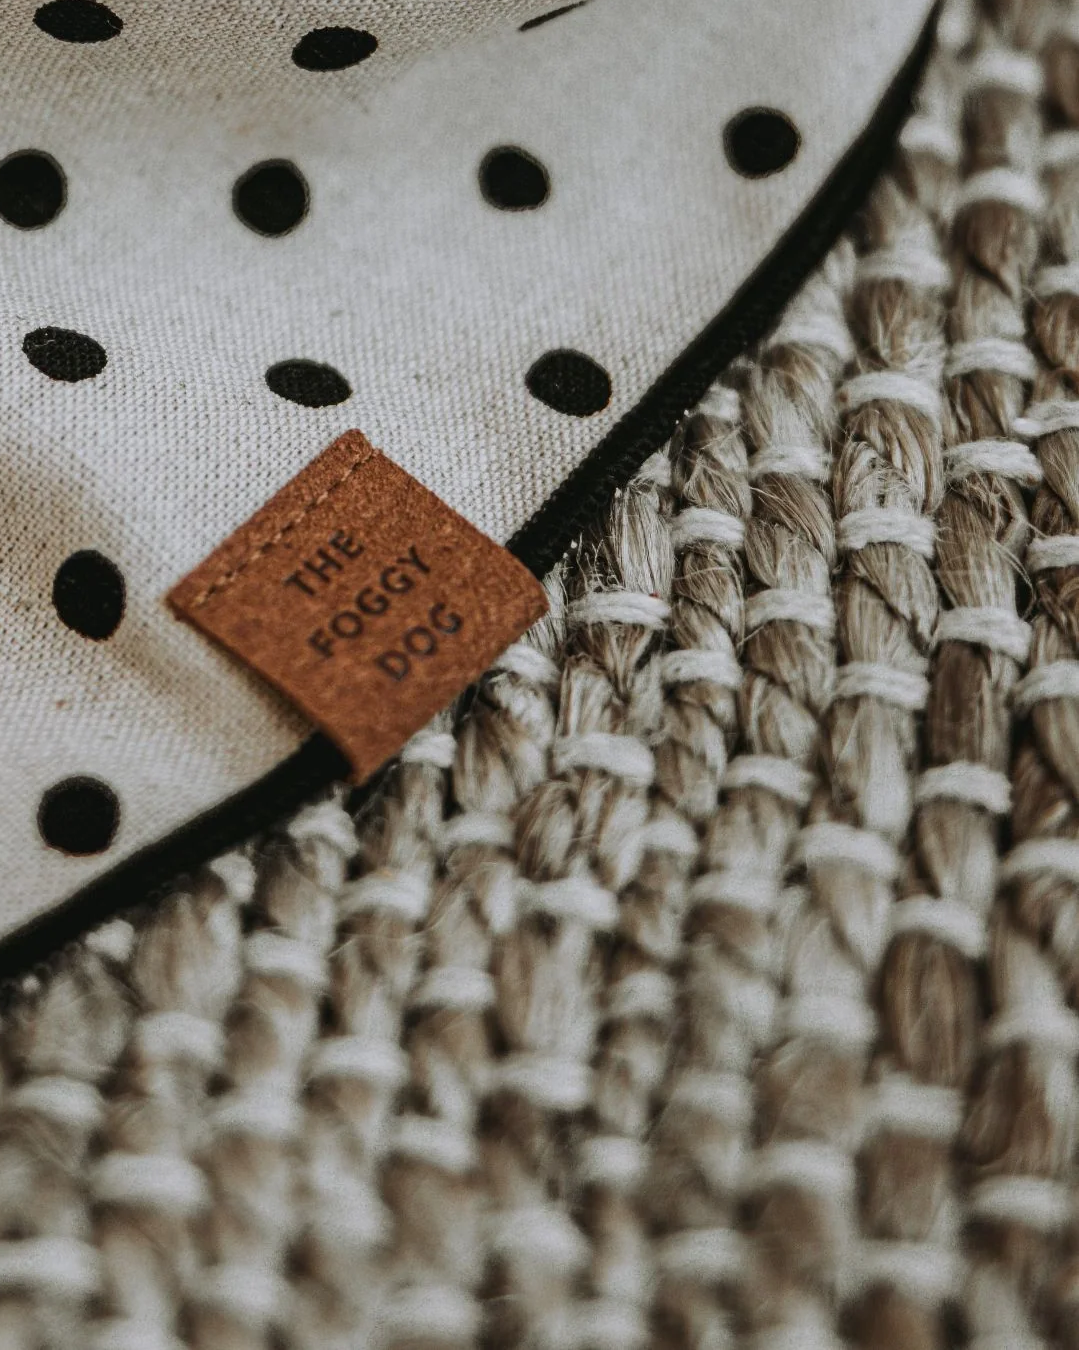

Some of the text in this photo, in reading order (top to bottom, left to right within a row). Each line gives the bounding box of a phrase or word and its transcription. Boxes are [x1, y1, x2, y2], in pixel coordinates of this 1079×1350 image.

[284, 529, 365, 598] THE
[307, 545, 431, 660] FOGGY
[377, 602, 463, 681] DOG
